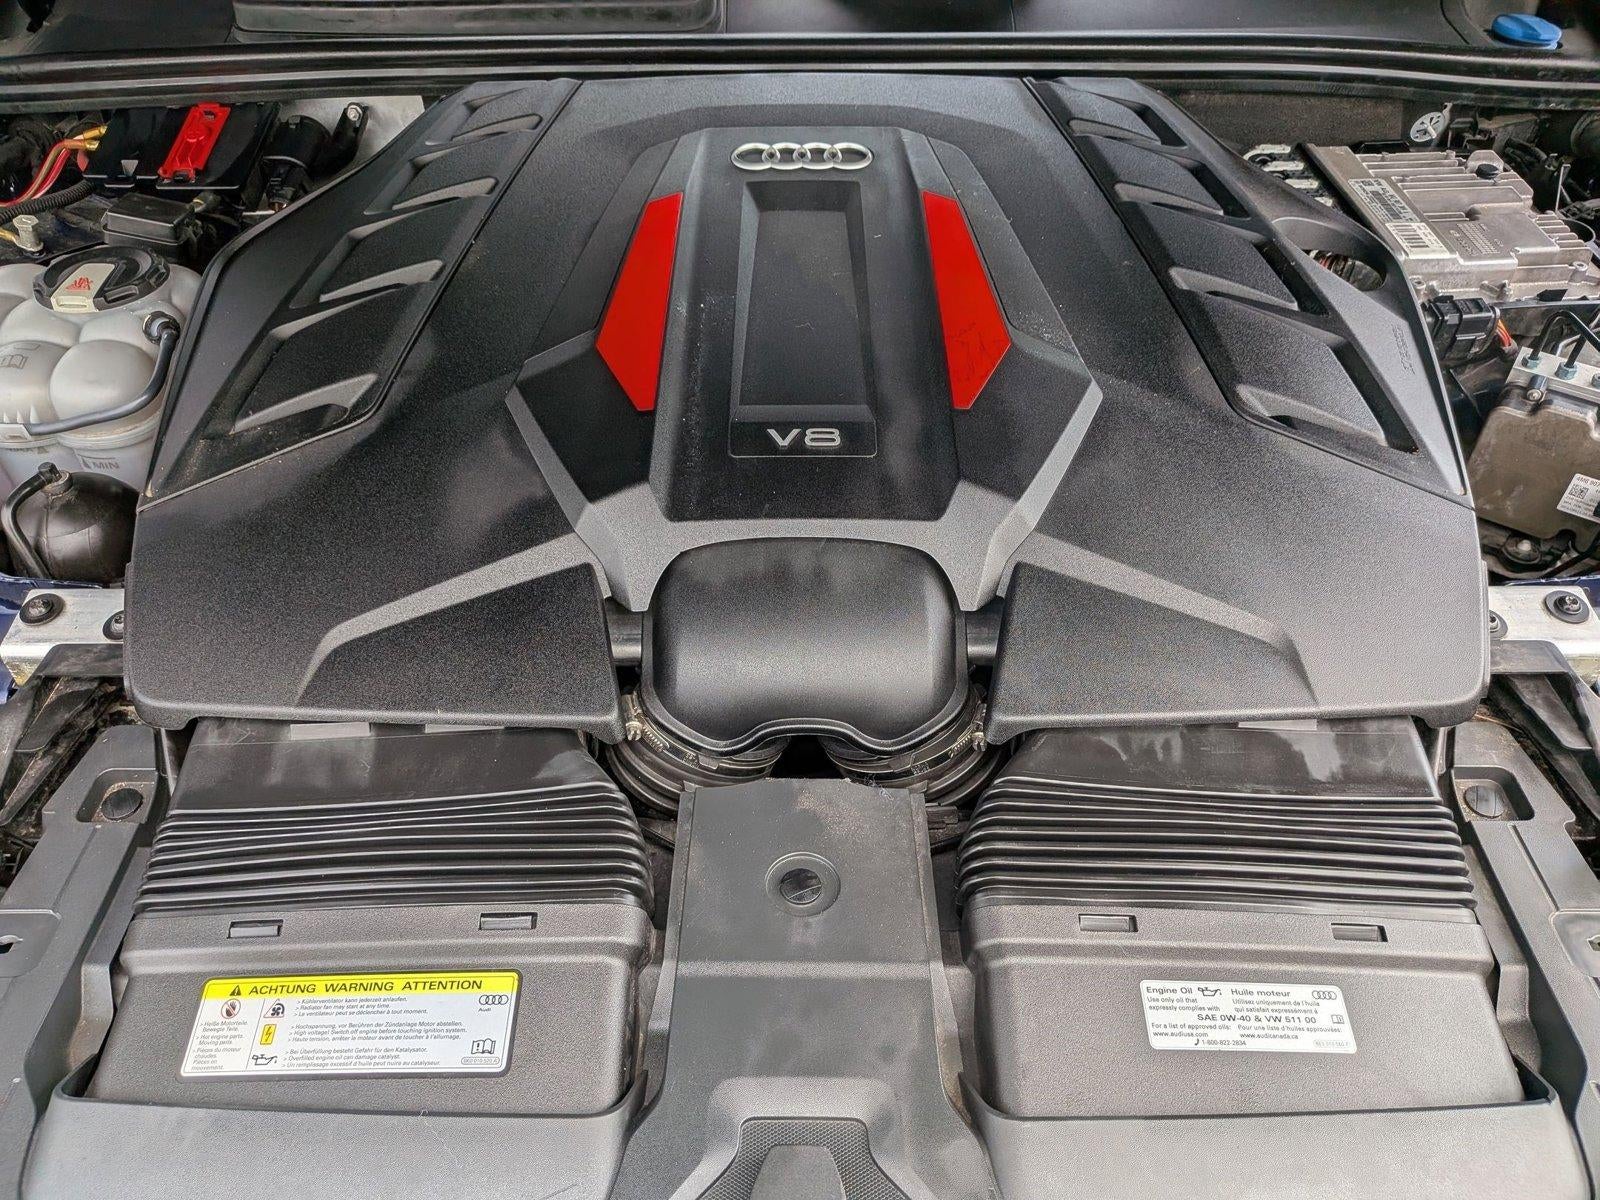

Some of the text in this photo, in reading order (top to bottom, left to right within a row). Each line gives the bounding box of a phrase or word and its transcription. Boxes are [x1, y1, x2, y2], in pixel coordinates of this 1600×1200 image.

[766, 428, 841, 447] V8
[93, 461, 120, 470] MIN
[249, 980, 482, 995] ACHTUNG WARNING ATTENTION
[1146, 986, 1177, 995] Engine
[1257, 989, 1291, 997] moteur
[1256, 999, 1292, 1007] uniquement
[1234, 1006, 1244, 1014] qui
[1197, 1013, 1217, 1021] SAE
[1220, 1014, 1251, 1022] 0W-40
